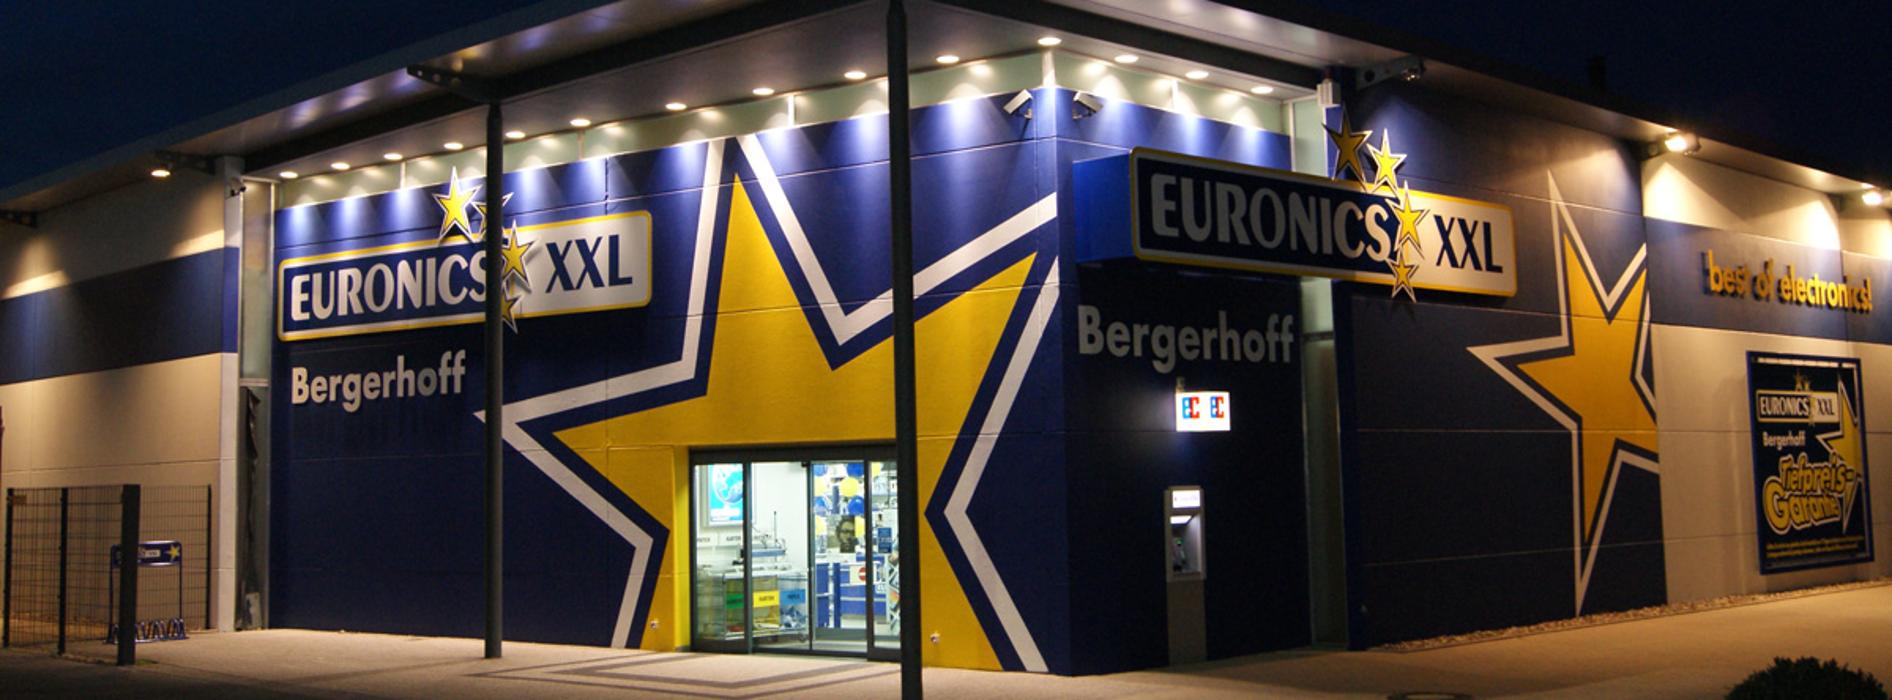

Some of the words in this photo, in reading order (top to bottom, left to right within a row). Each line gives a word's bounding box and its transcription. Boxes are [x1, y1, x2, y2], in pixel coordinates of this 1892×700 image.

[1150, 173, 1392, 262] EURONICS
[1435, 215, 1503, 273] XXL
[292, 250, 486, 321] EURONICS
[545, 234, 633, 293] XXL
[1706, 249, 1748, 297] best
[1756, 258, 1775, 298] of
[1780, 264, 1873, 312] electronics!
[1078, 305, 1294, 374] Bergerhoff
[292, 350, 466, 412] Bergerhoff
[1760, 396, 1809, 417] EURONICS
[1817, 399, 1834, 416] XXL
[1762, 431, 1806, 451] Bergerhoff
[1763, 476, 1842, 533] Garantie
